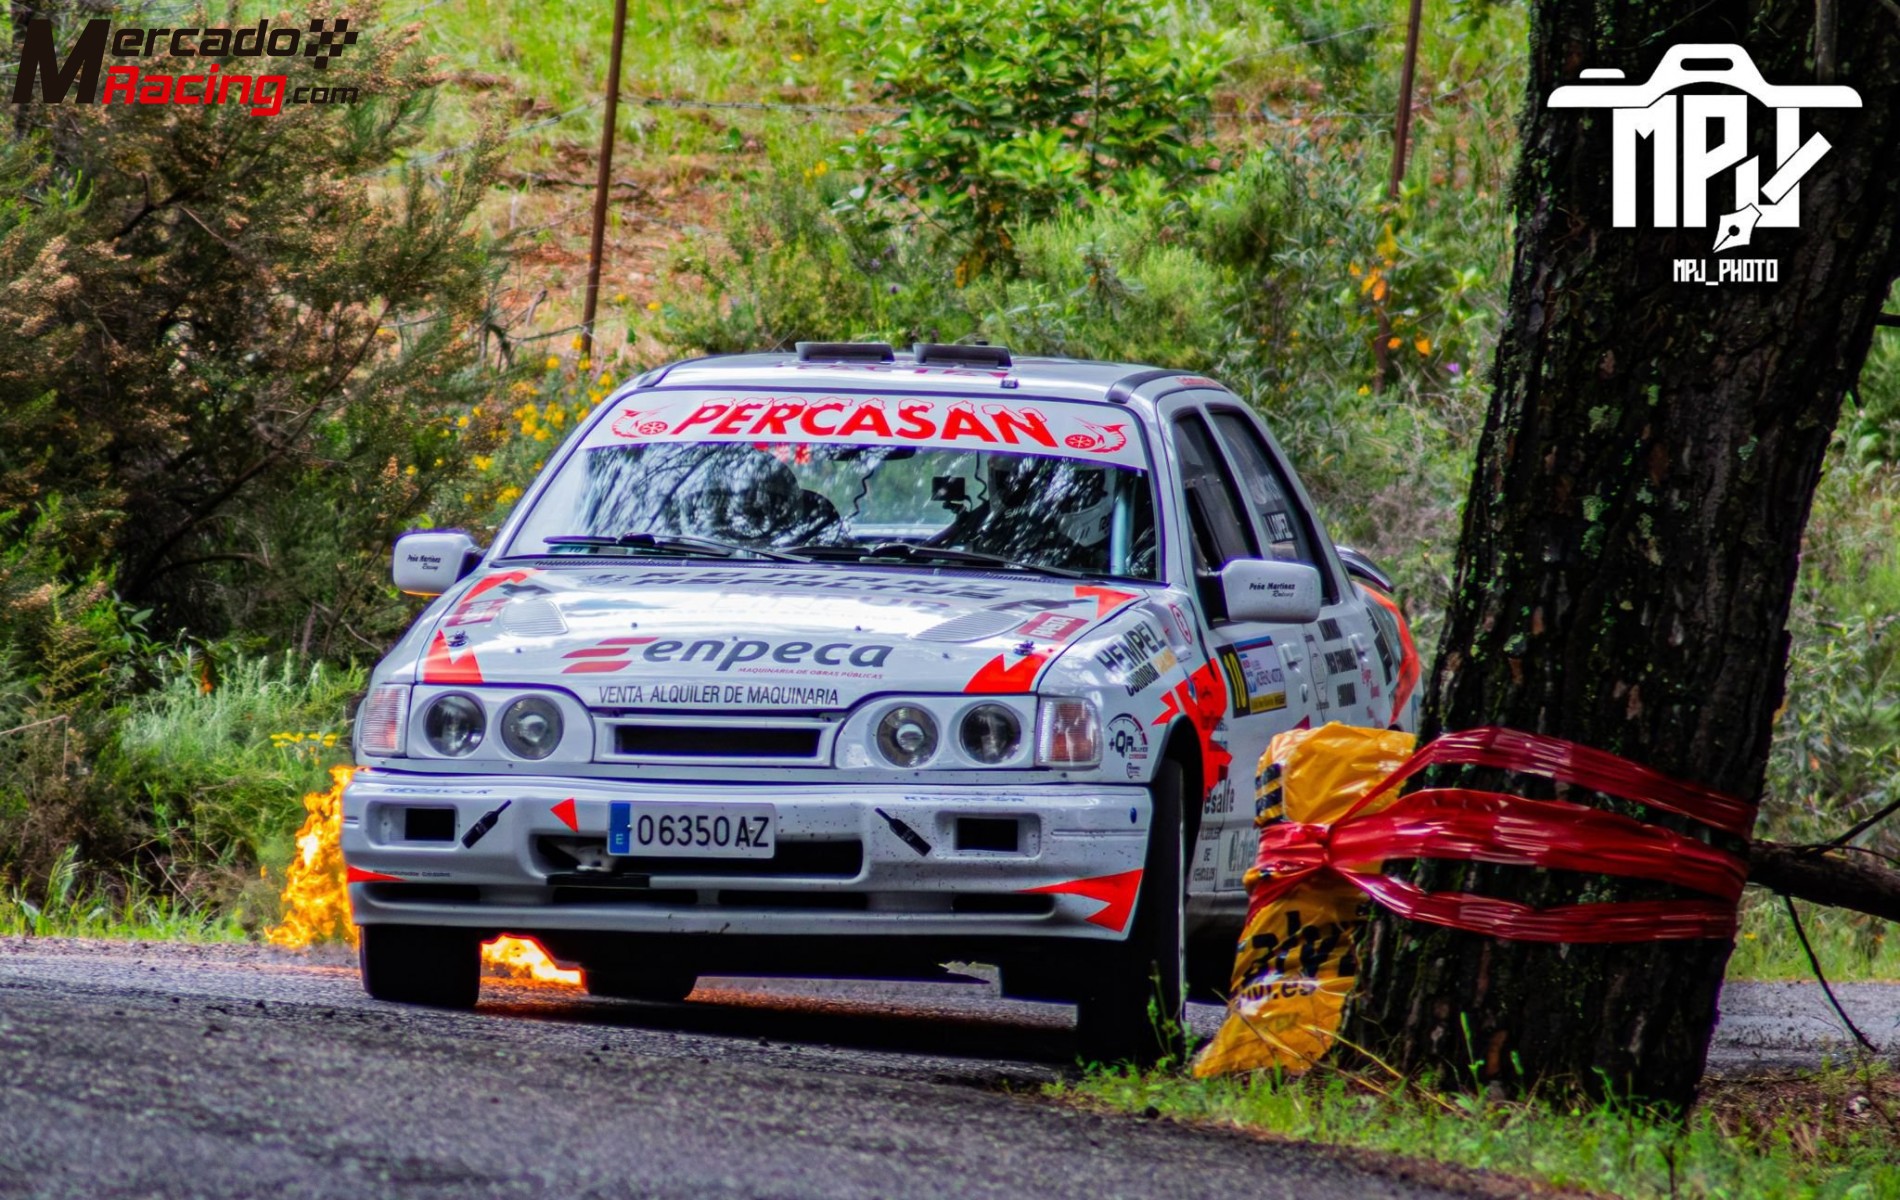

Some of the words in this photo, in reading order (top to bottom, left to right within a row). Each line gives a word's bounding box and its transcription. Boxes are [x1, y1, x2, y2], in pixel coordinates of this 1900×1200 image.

[668, 396, 1060, 448] PERCASAN
[631, 578, 1006, 600] ASFALTOS
[642, 637, 894, 672] enpeca
[1095, 621, 1166, 673] HEMPEL
[599, 686, 643, 703] VENTA
[650, 685, 720, 704] ALQUILER
[724, 686, 743, 703] DE
[748, 686, 839, 705] MAQUINARIA
